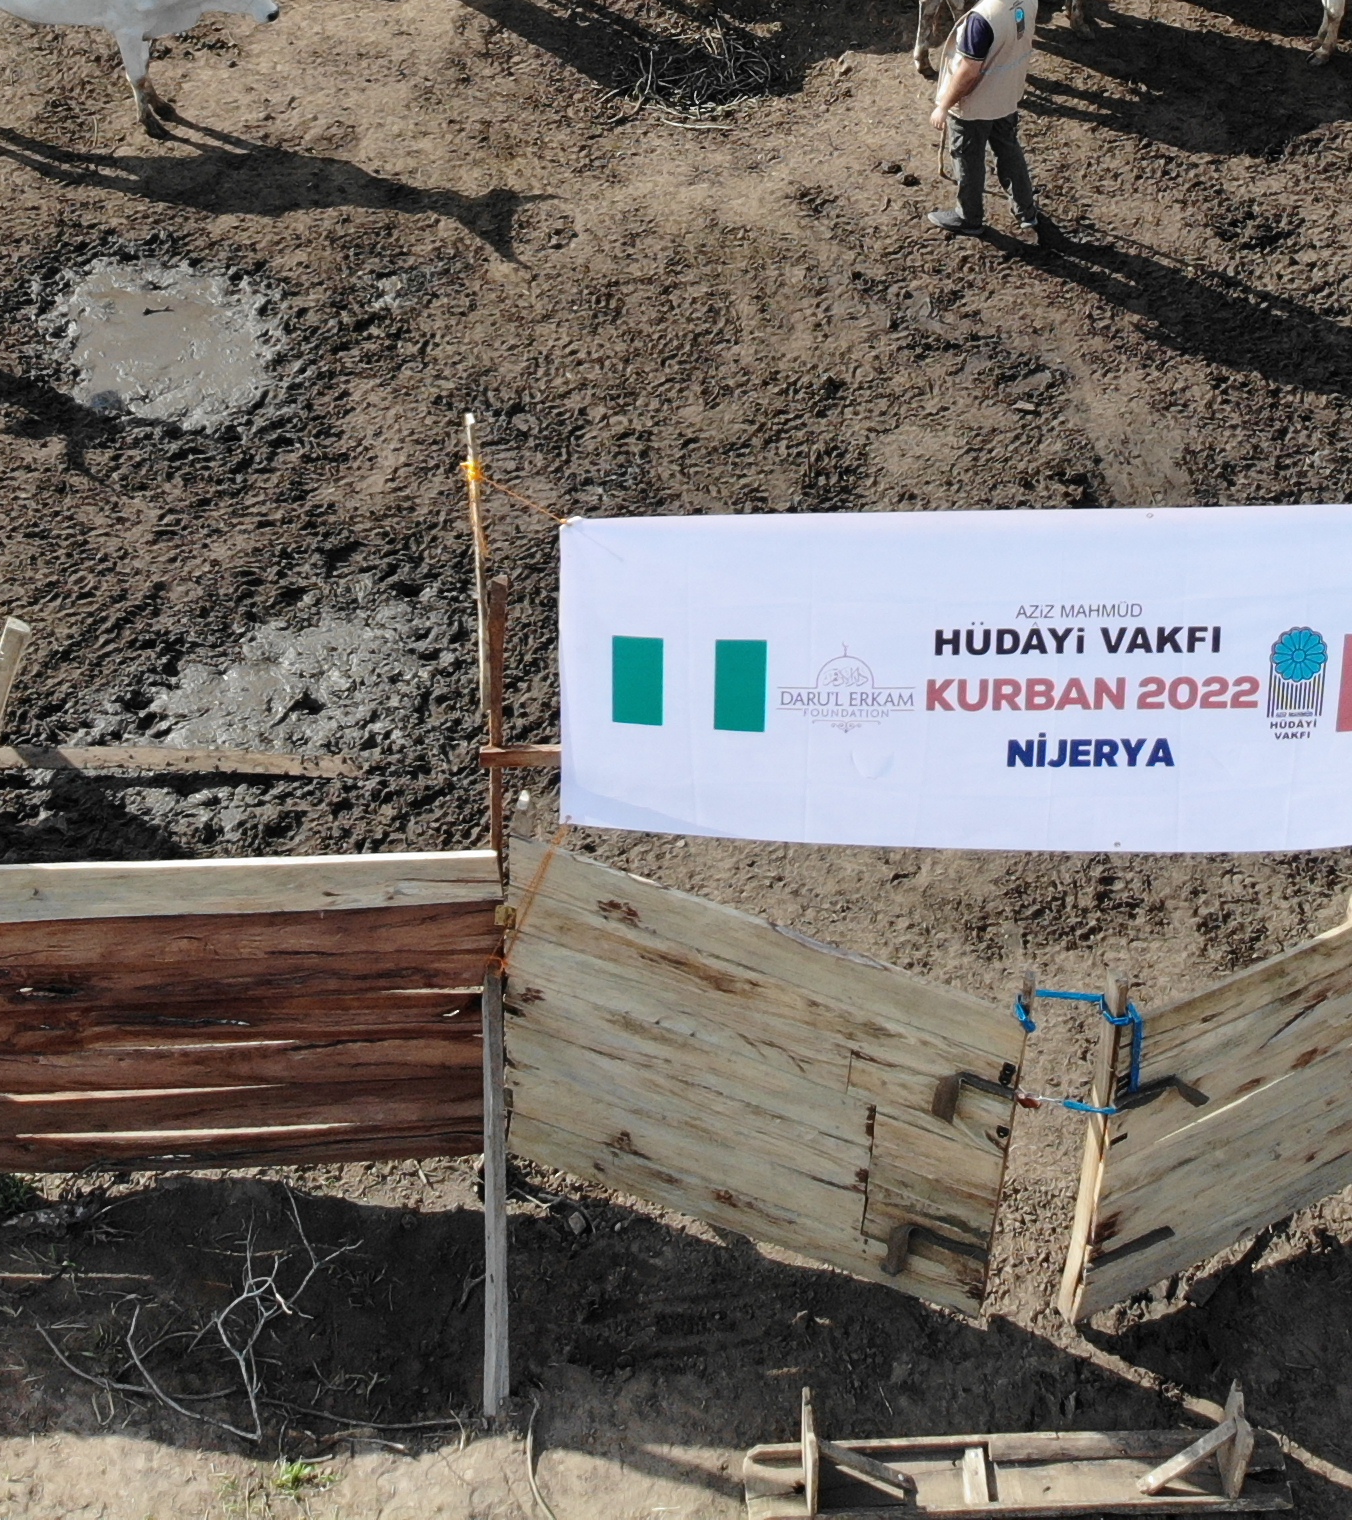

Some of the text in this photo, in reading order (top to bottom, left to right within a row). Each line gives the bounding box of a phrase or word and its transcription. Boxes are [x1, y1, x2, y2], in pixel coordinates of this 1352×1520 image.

[1100, 626, 1222, 654] VAKFI
[849, 691, 914, 707] ERKAM
[925, 676, 1260, 712] KURBAN 2022
[803, 708, 890, 718] FOUNDATION
